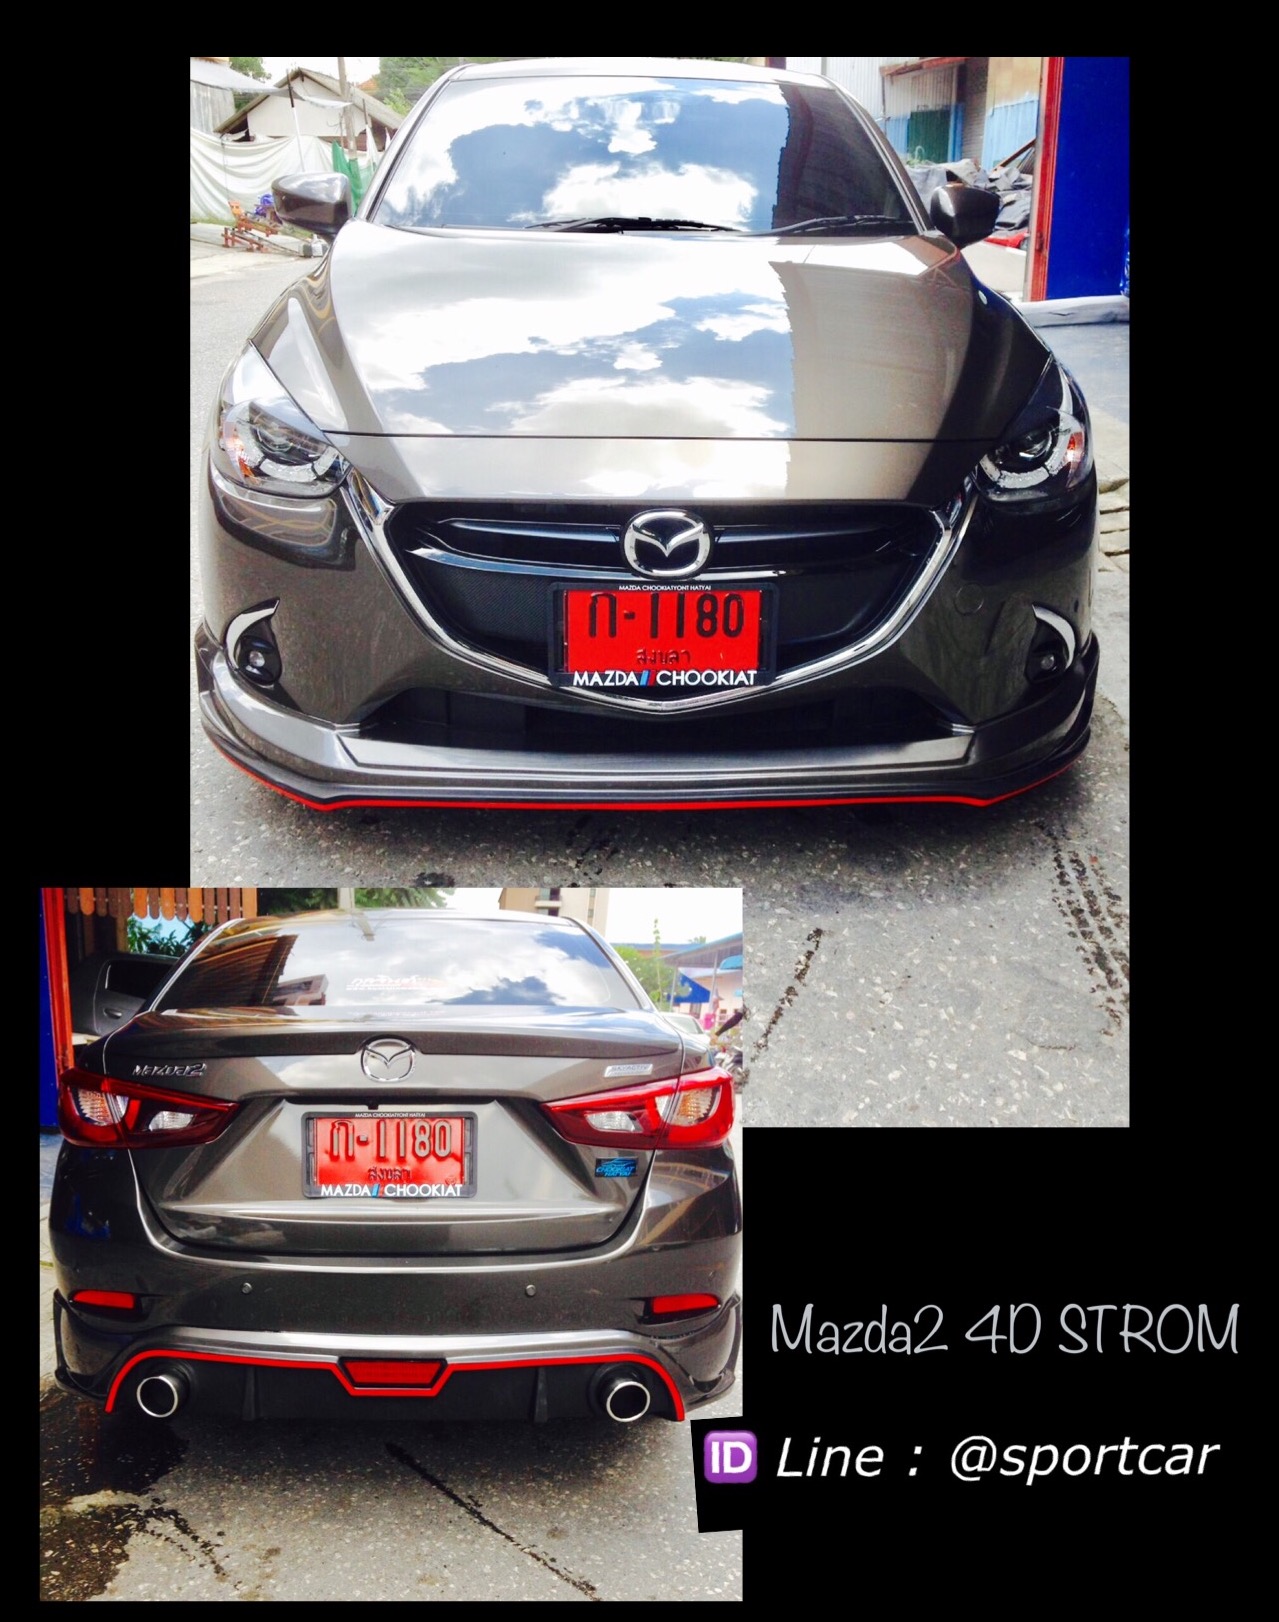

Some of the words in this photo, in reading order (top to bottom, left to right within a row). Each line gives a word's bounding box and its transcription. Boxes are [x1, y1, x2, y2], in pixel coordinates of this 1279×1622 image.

[573, 670, 639, 686] MAZDA
[656, 670, 758, 686] CHOOKIAT
[321, 1184, 371, 1197] MAZDA
[384, 1184, 463, 1197] CHOOKIAT
